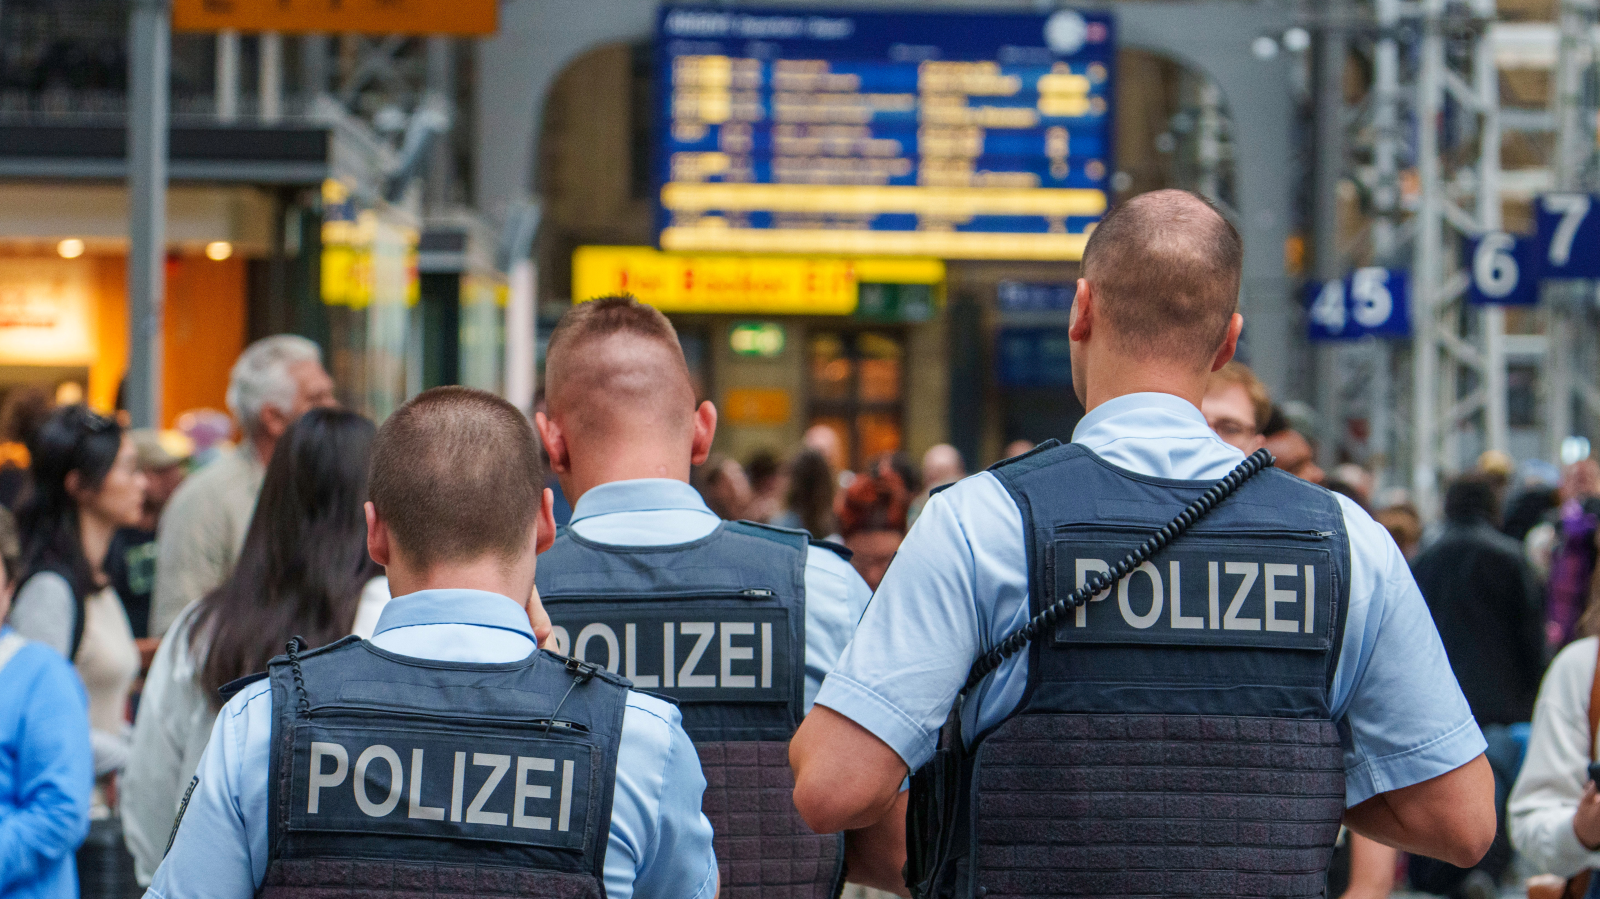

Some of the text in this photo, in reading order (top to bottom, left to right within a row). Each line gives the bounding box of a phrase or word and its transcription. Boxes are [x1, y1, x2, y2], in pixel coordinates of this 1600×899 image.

[1473, 231, 1519, 298] 6
[1542, 193, 1590, 266] 7
[1310, 279, 1347, 334] 4
[1351, 266, 1393, 327] 5
[1075, 558, 1315, 634] POLIZEI
[307, 742, 575, 832] POLIZEI
